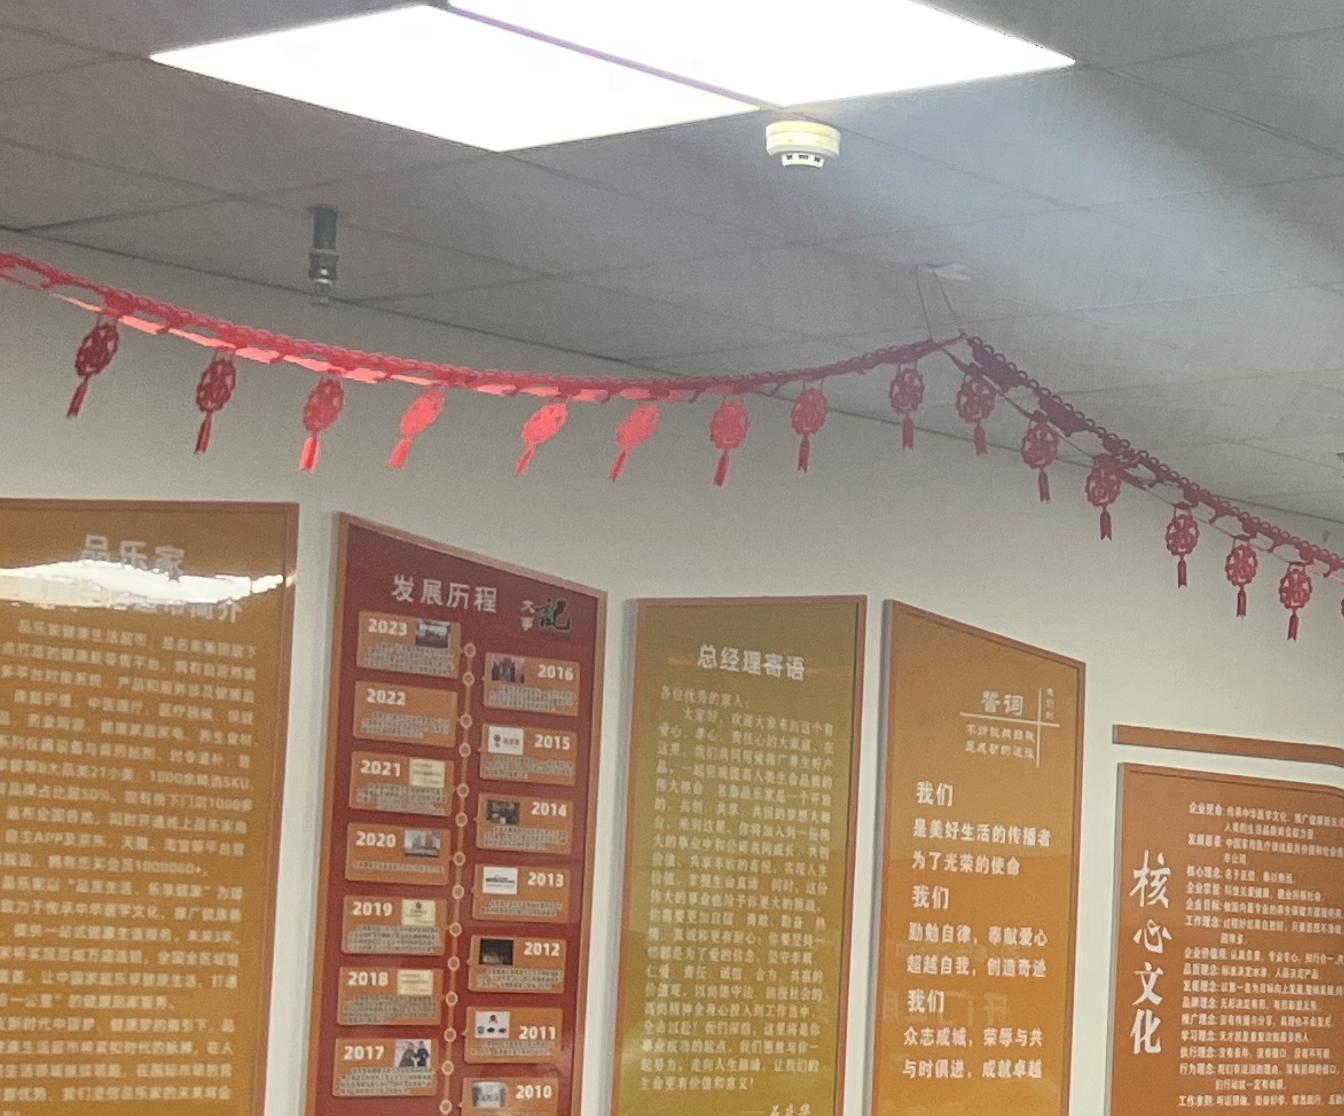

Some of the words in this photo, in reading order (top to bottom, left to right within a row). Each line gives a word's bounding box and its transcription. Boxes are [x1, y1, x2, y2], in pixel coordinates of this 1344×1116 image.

[392, 574, 497, 613] 发展历程
[367, 618, 408, 637] 2023
[698, 644, 805, 680] 总经理寄语
[537, 664, 574, 682] 2016
[366, 689, 407, 707] 2022
[981, 690, 1024, 717] 誓词
[534, 734, 570, 751] 2015
[360, 759, 401, 777] 2021
[917, 780, 953, 807] 我们
[532, 802, 568, 819] 2014
[356, 831, 397, 850] 2020
[913, 818, 1052, 847] 是美好生活的传播者
[912, 850, 1020, 876] 为了光荣的使命
[527, 872, 564, 889] 2013
[912, 884, 949, 910] 我们
[352, 901, 393, 919] 2019
[523, 941, 560, 958] 2012
[1130, 850, 1172, 1054] 核心文化
[906, 953, 1047, 980] 超越自我，创造奇迹
[347, 970, 389, 988] 2018
[907, 988, 945, 1014] 我们
[519, 1026, 556, 1042] 2011
[903, 1025, 1043, 1048] 众志成城，荣辱与共
[343, 1044, 385, 1063] 2017
[902, 1057, 1043, 1081] 与时俱进，成就卓越
[515, 1084, 552, 1101] 2010
